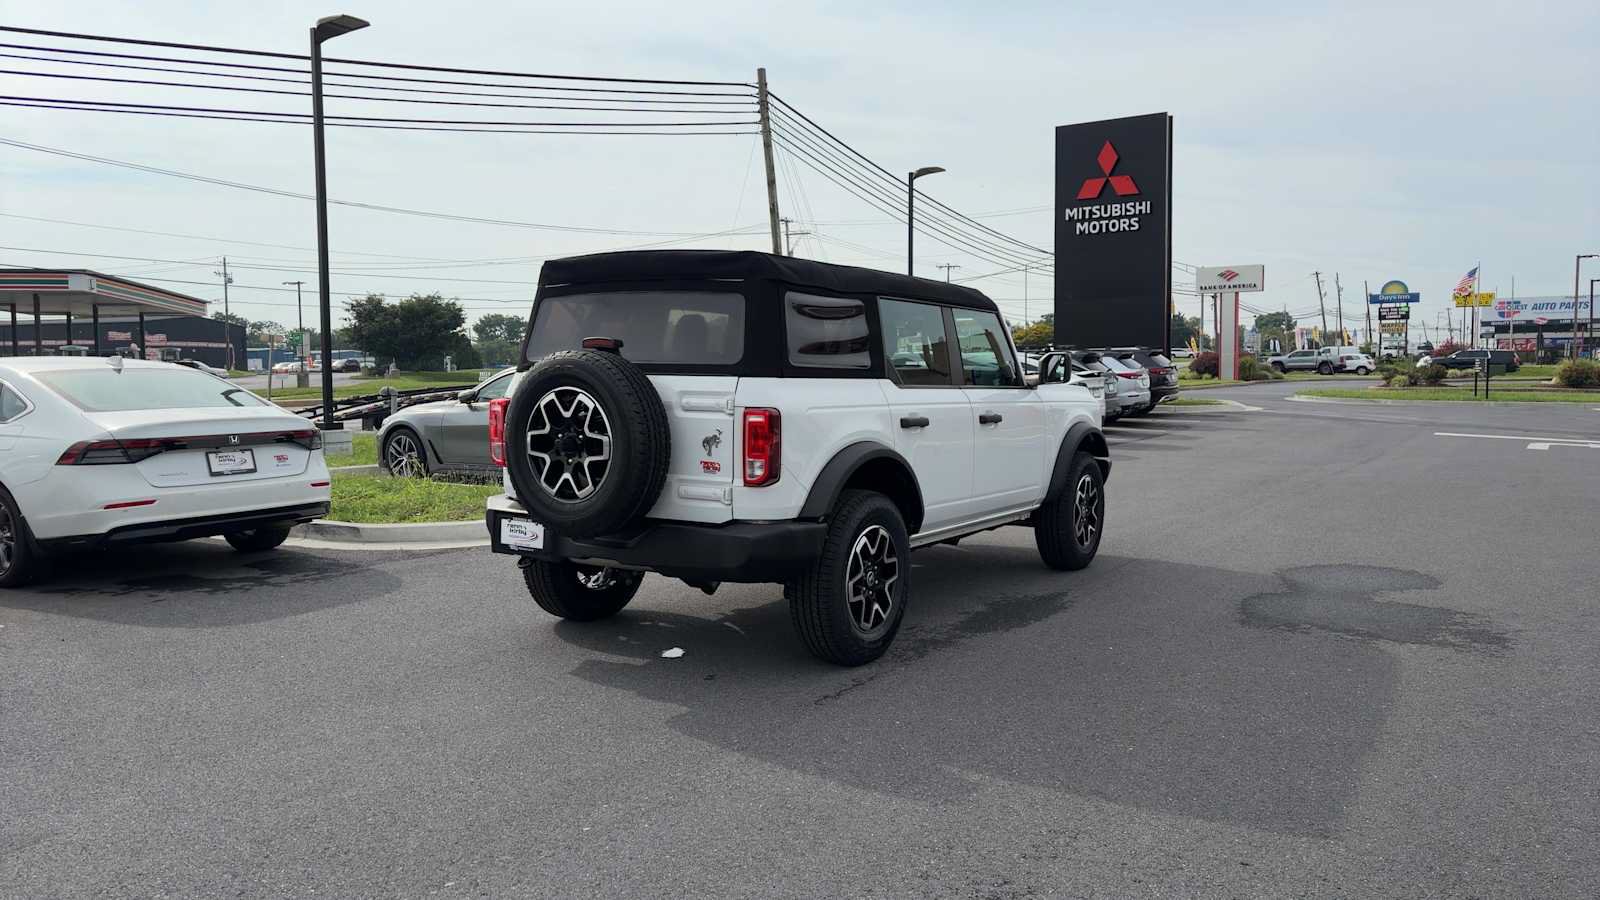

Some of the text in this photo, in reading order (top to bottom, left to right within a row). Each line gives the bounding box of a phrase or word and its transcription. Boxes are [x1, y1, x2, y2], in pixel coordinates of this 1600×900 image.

[1065, 201, 1151, 221] MITSUBISHI
[1075, 217, 1140, 235] MOTORS
[1531, 302, 1556, 311] AUTO
